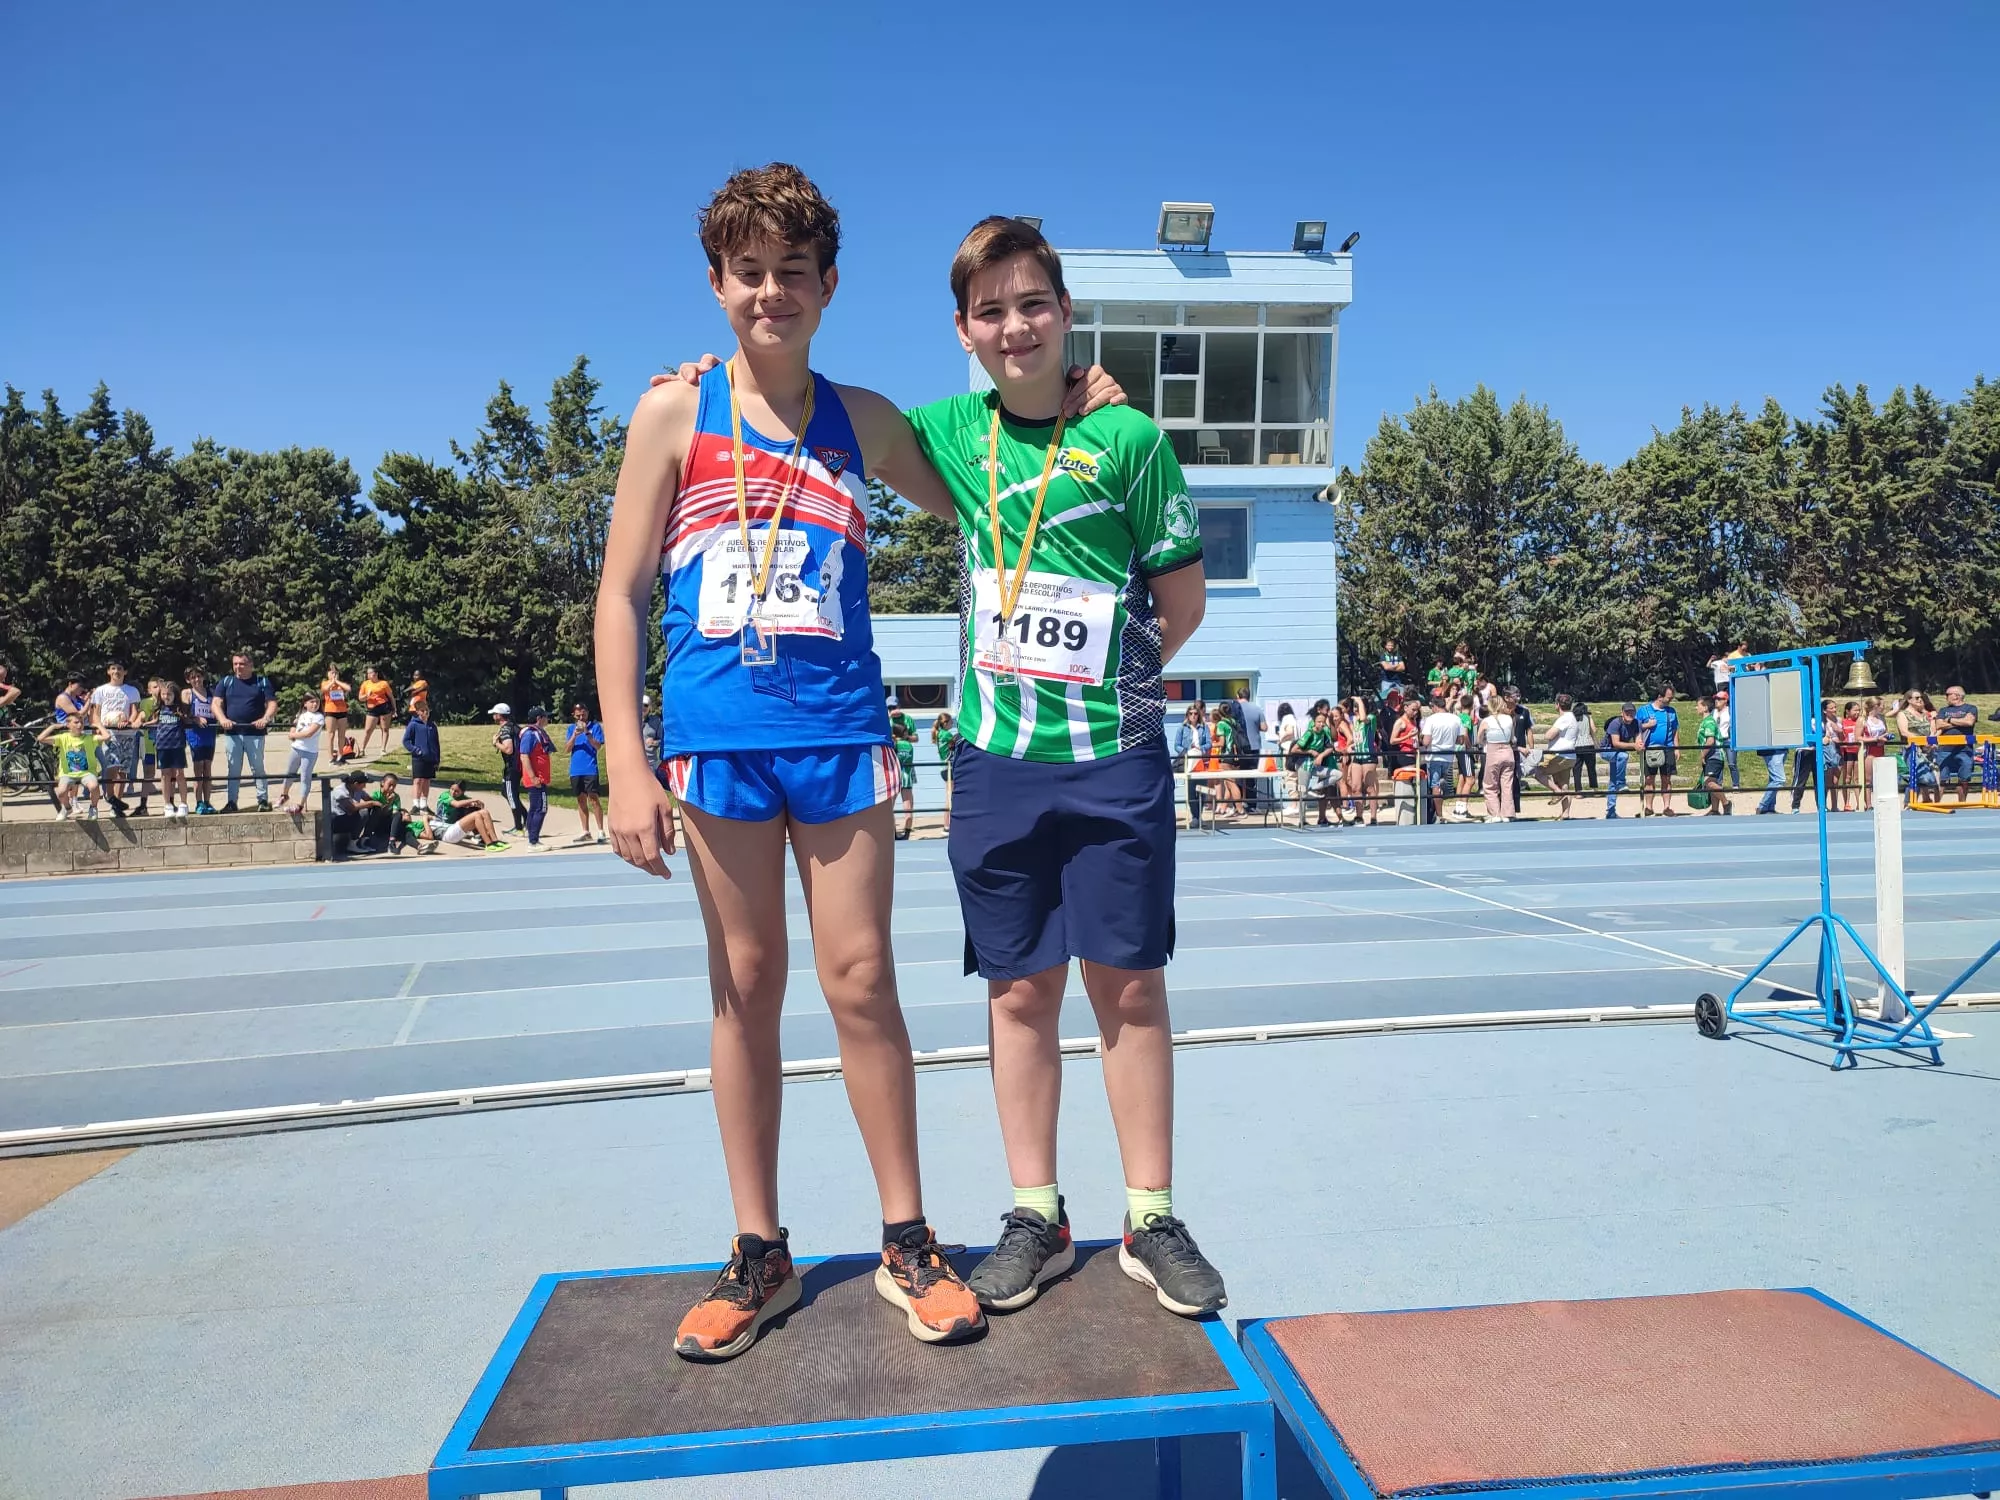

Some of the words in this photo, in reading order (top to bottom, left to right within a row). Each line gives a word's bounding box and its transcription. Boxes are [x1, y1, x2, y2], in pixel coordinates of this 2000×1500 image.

[757, 539, 806, 547] DERTIVOS
[1029, 582, 1073, 595] DEPORTIVOS
[1030, 588, 1061, 599] ESCOLAR
[992, 611, 1088, 652] 1189
